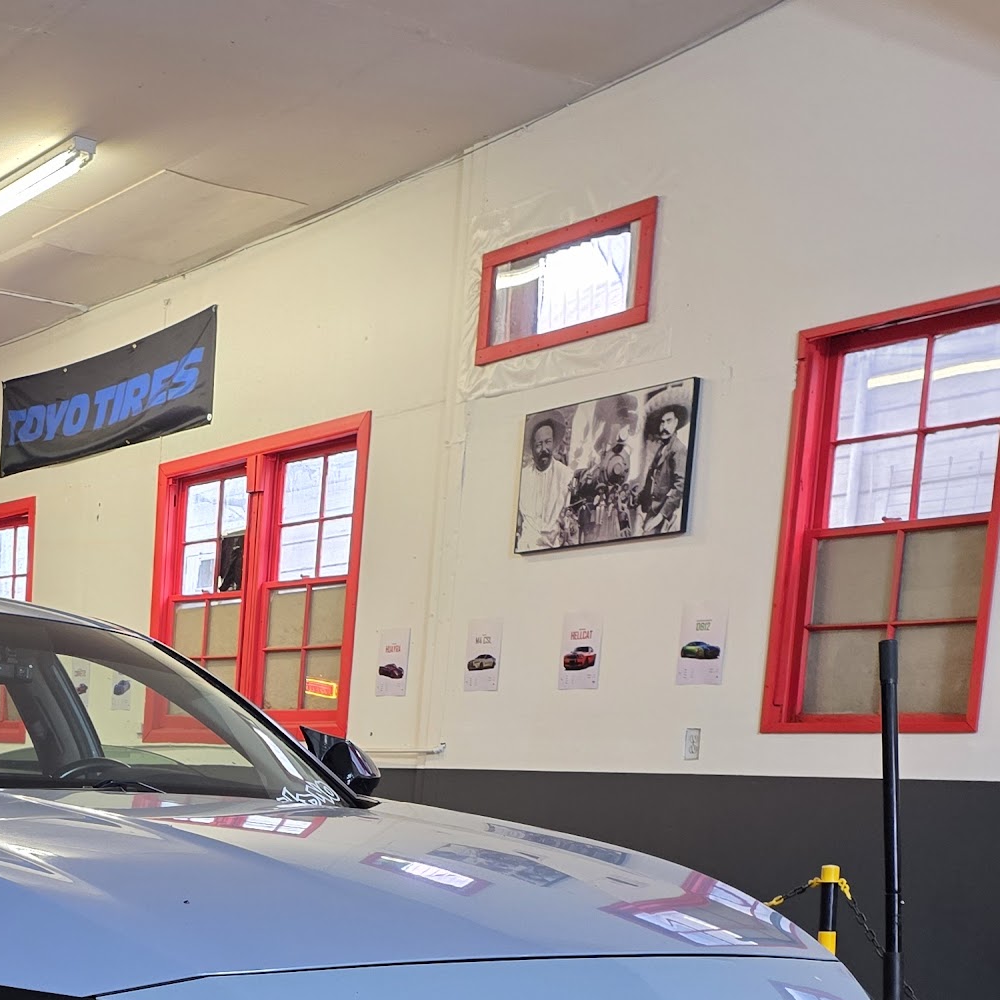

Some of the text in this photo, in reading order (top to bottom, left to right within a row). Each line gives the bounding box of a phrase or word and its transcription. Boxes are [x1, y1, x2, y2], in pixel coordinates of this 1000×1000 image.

[8, 347, 205, 446] TOYO TIRES
[570, 630, 593, 640] HELLCAT
